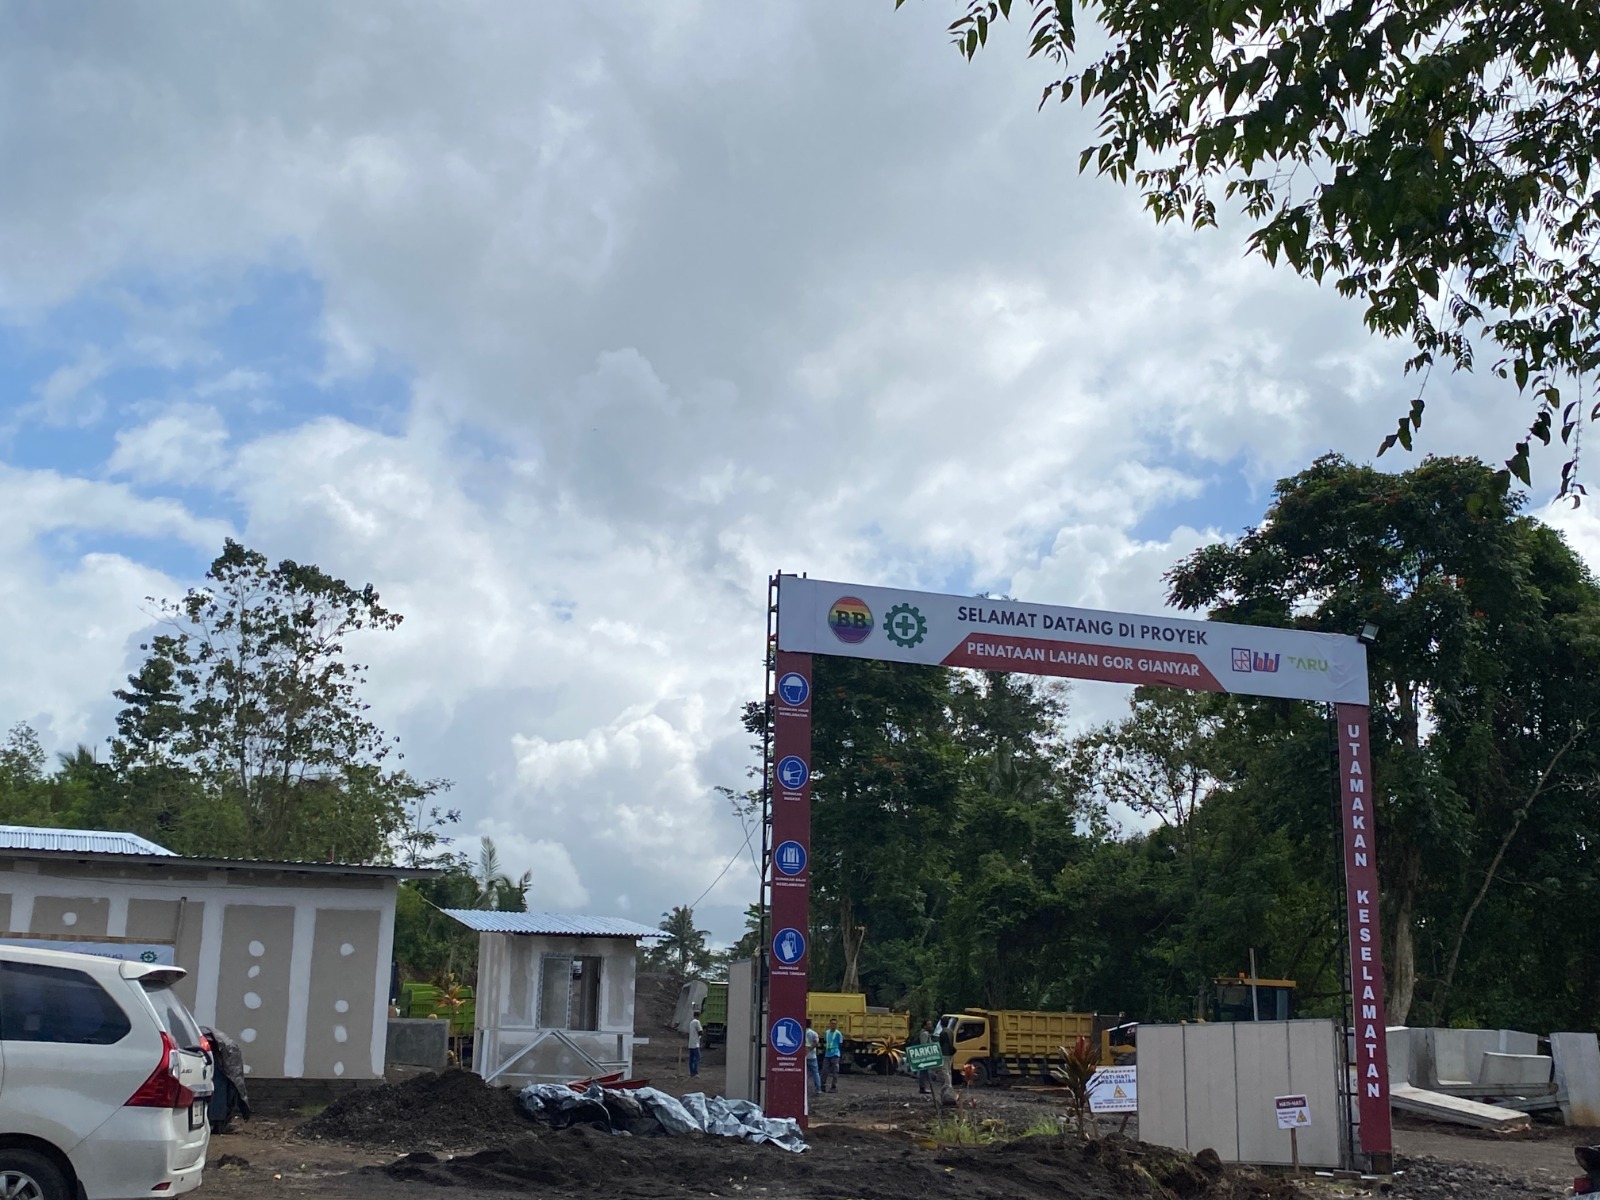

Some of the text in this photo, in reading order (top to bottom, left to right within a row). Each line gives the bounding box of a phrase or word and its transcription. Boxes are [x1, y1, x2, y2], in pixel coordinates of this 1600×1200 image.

[835, 609, 868, 630] BB
[957, 606, 1208, 645] SELAMAT DATANG DI PROYEK
[967, 642, 1200, 677] PENATAAN LAHAN GOR GIANYAR
[1287, 656, 1329, 672] TARU
[1347, 724, 1381, 1099] UTAMAKAN KESELAMATAN
[909, 1045, 940, 1058] PARKIR
